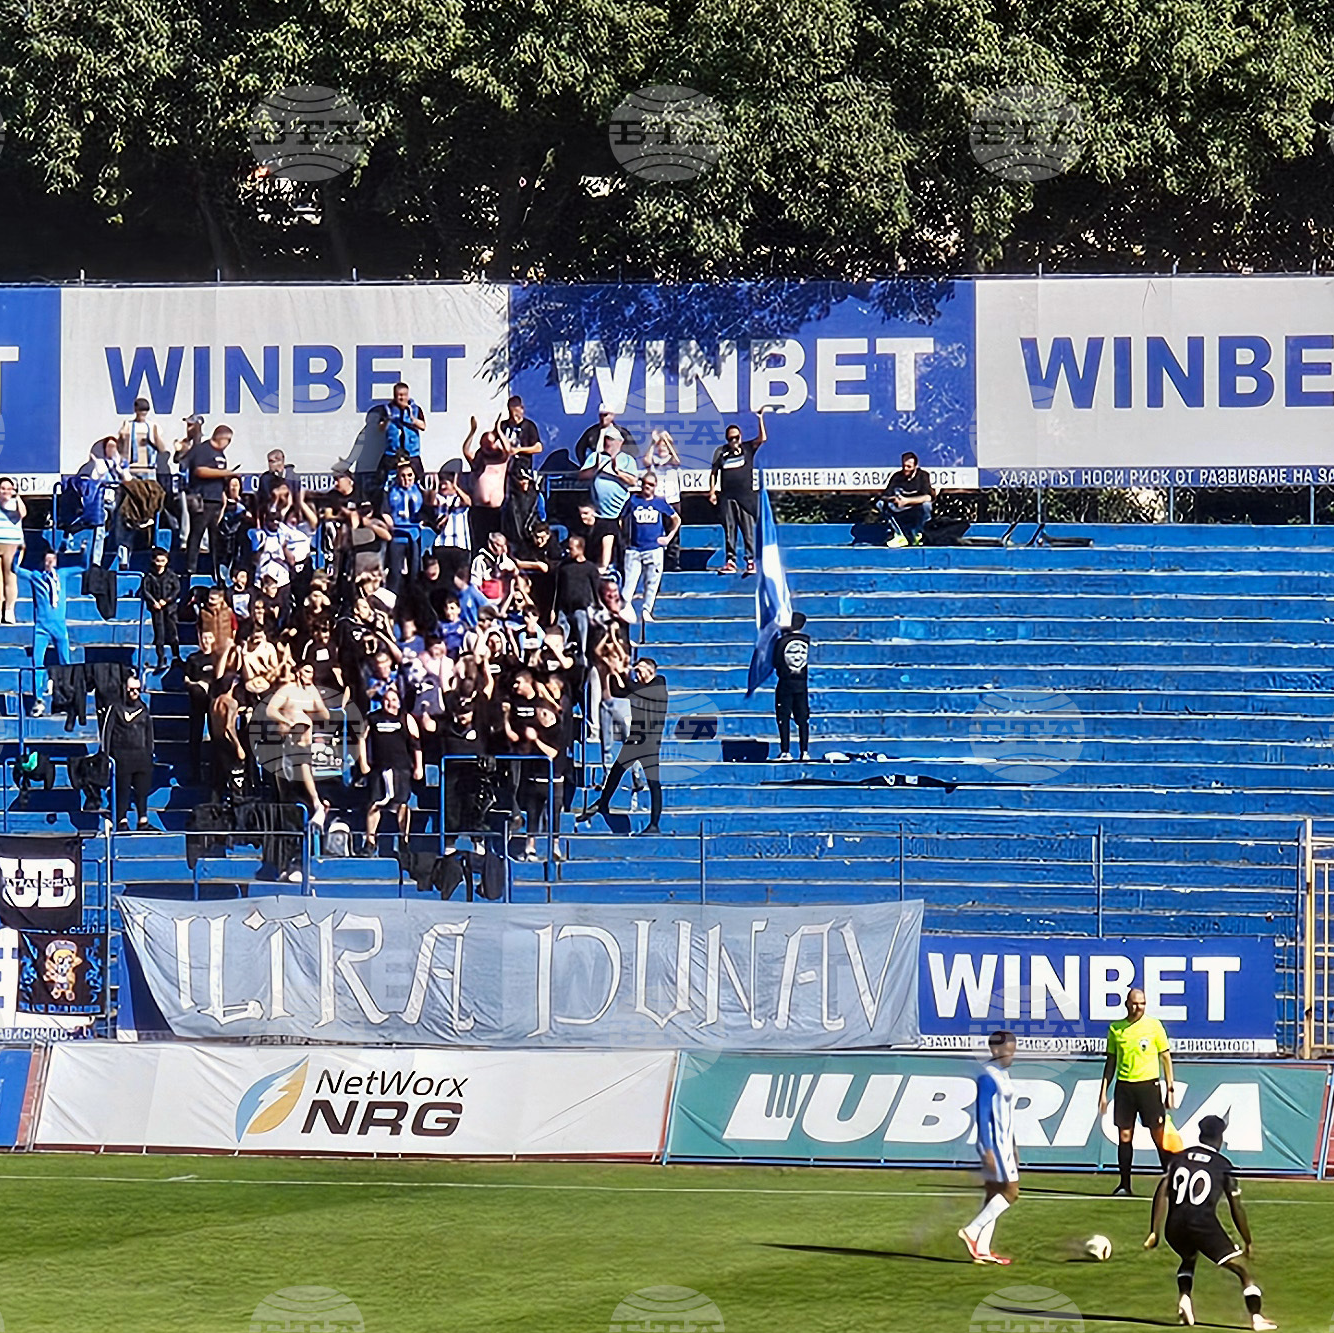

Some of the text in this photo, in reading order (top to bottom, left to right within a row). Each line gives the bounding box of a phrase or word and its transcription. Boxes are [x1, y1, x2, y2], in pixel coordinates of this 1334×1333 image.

[104, 344, 466, 416] WINBET
[552, 336, 937, 416] WINBET
[827, 471, 847, 486] НА
[1082, 469, 1124, 486] НОСИ
[1129, 469, 1171, 485] РИСК
[1175, 469, 1195, 485] ОТ
[1199, 468, 1287, 485] РАЗВИВАНЕ
[1293, 468, 1313, 484] НА
[928, 953, 1242, 1022] WINBET
[316, 1068, 469, 1097] NetWorx
[300, 1099, 464, 1137] NRG
[1172, 1166, 1212, 1206] 90
